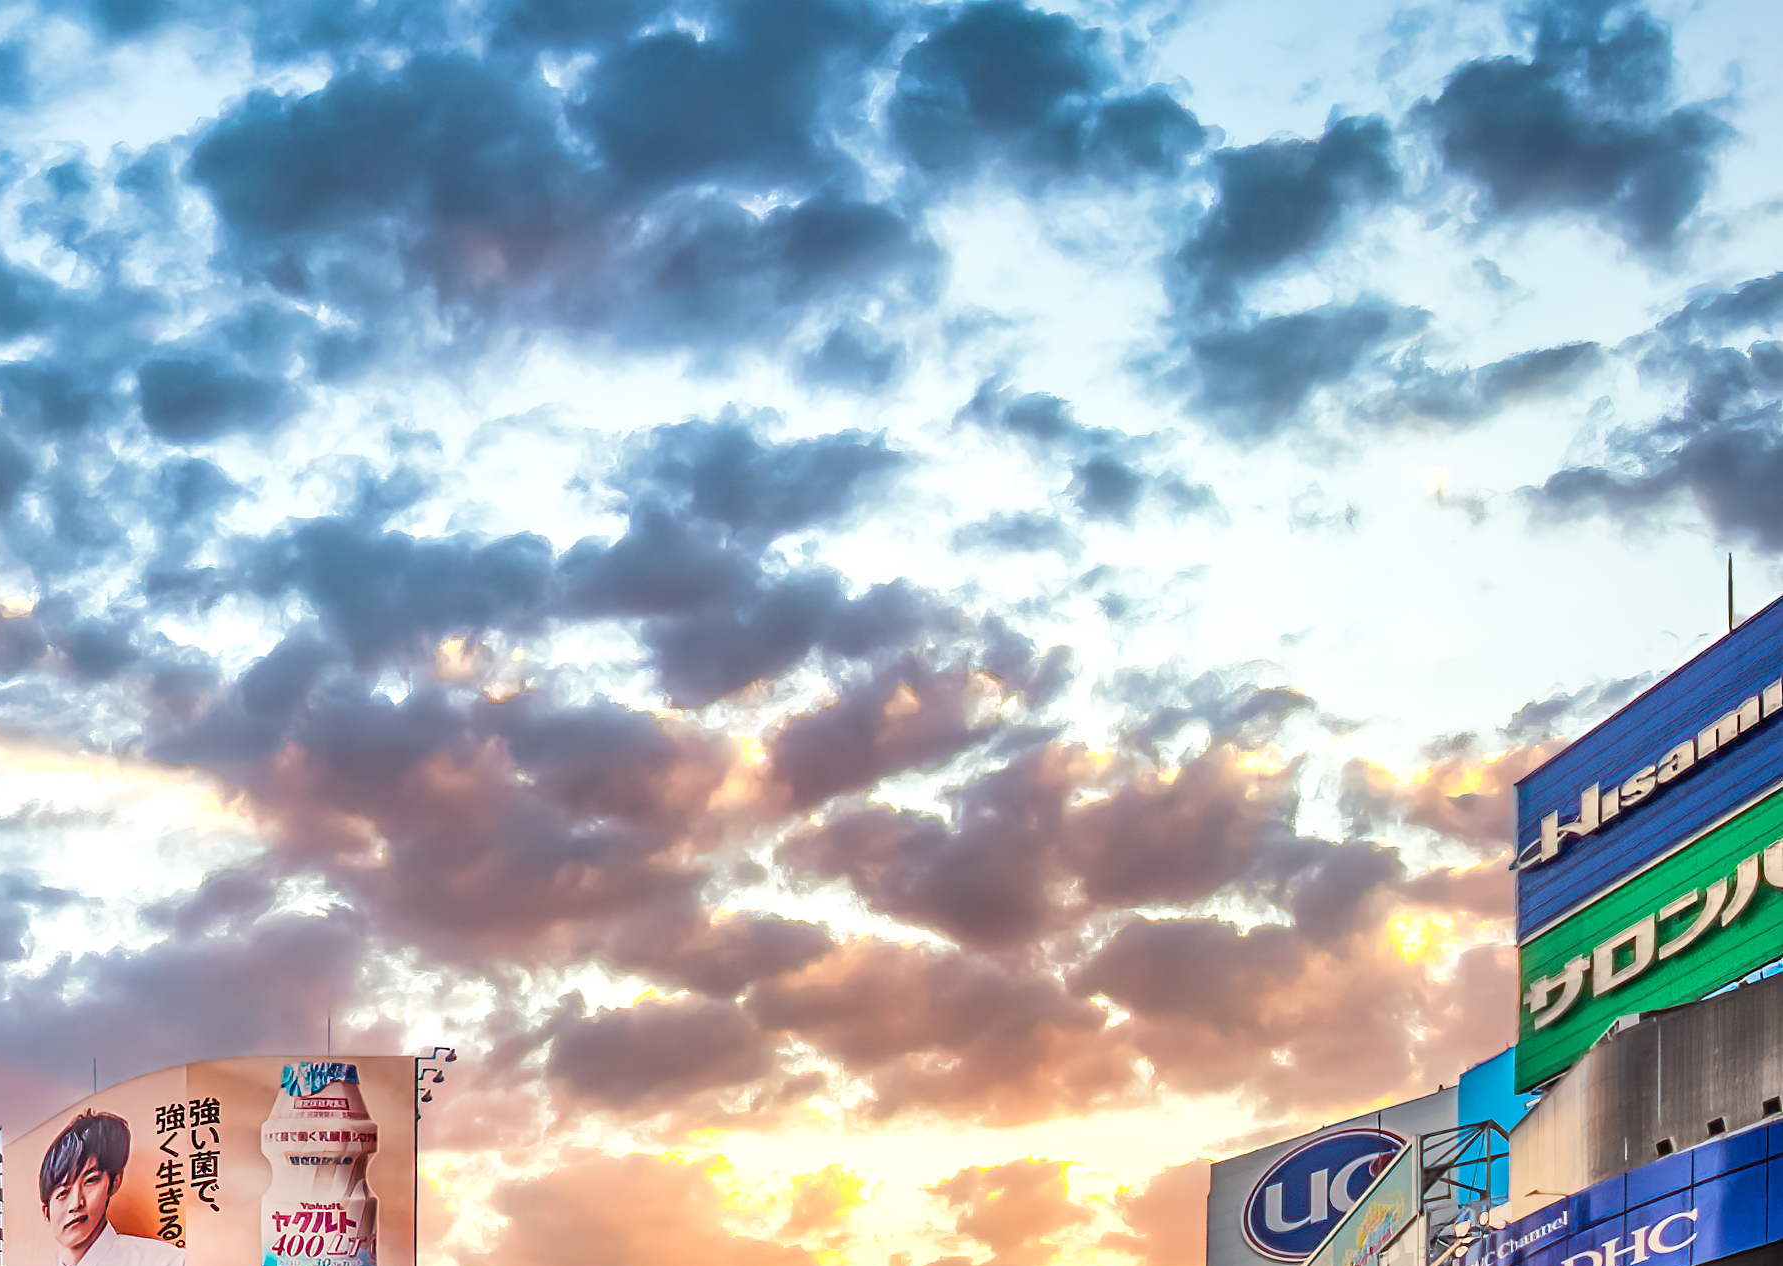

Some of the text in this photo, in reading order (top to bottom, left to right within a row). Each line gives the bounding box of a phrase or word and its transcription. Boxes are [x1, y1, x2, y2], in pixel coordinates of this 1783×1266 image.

[155, 1104, 186, 1249] 強く生きる。
[189, 1097, 221, 1212] 強い菌で、
[272, 1211, 356, 1233] ヤクルト
[1498, 1210, 1569, 1261] Channel
